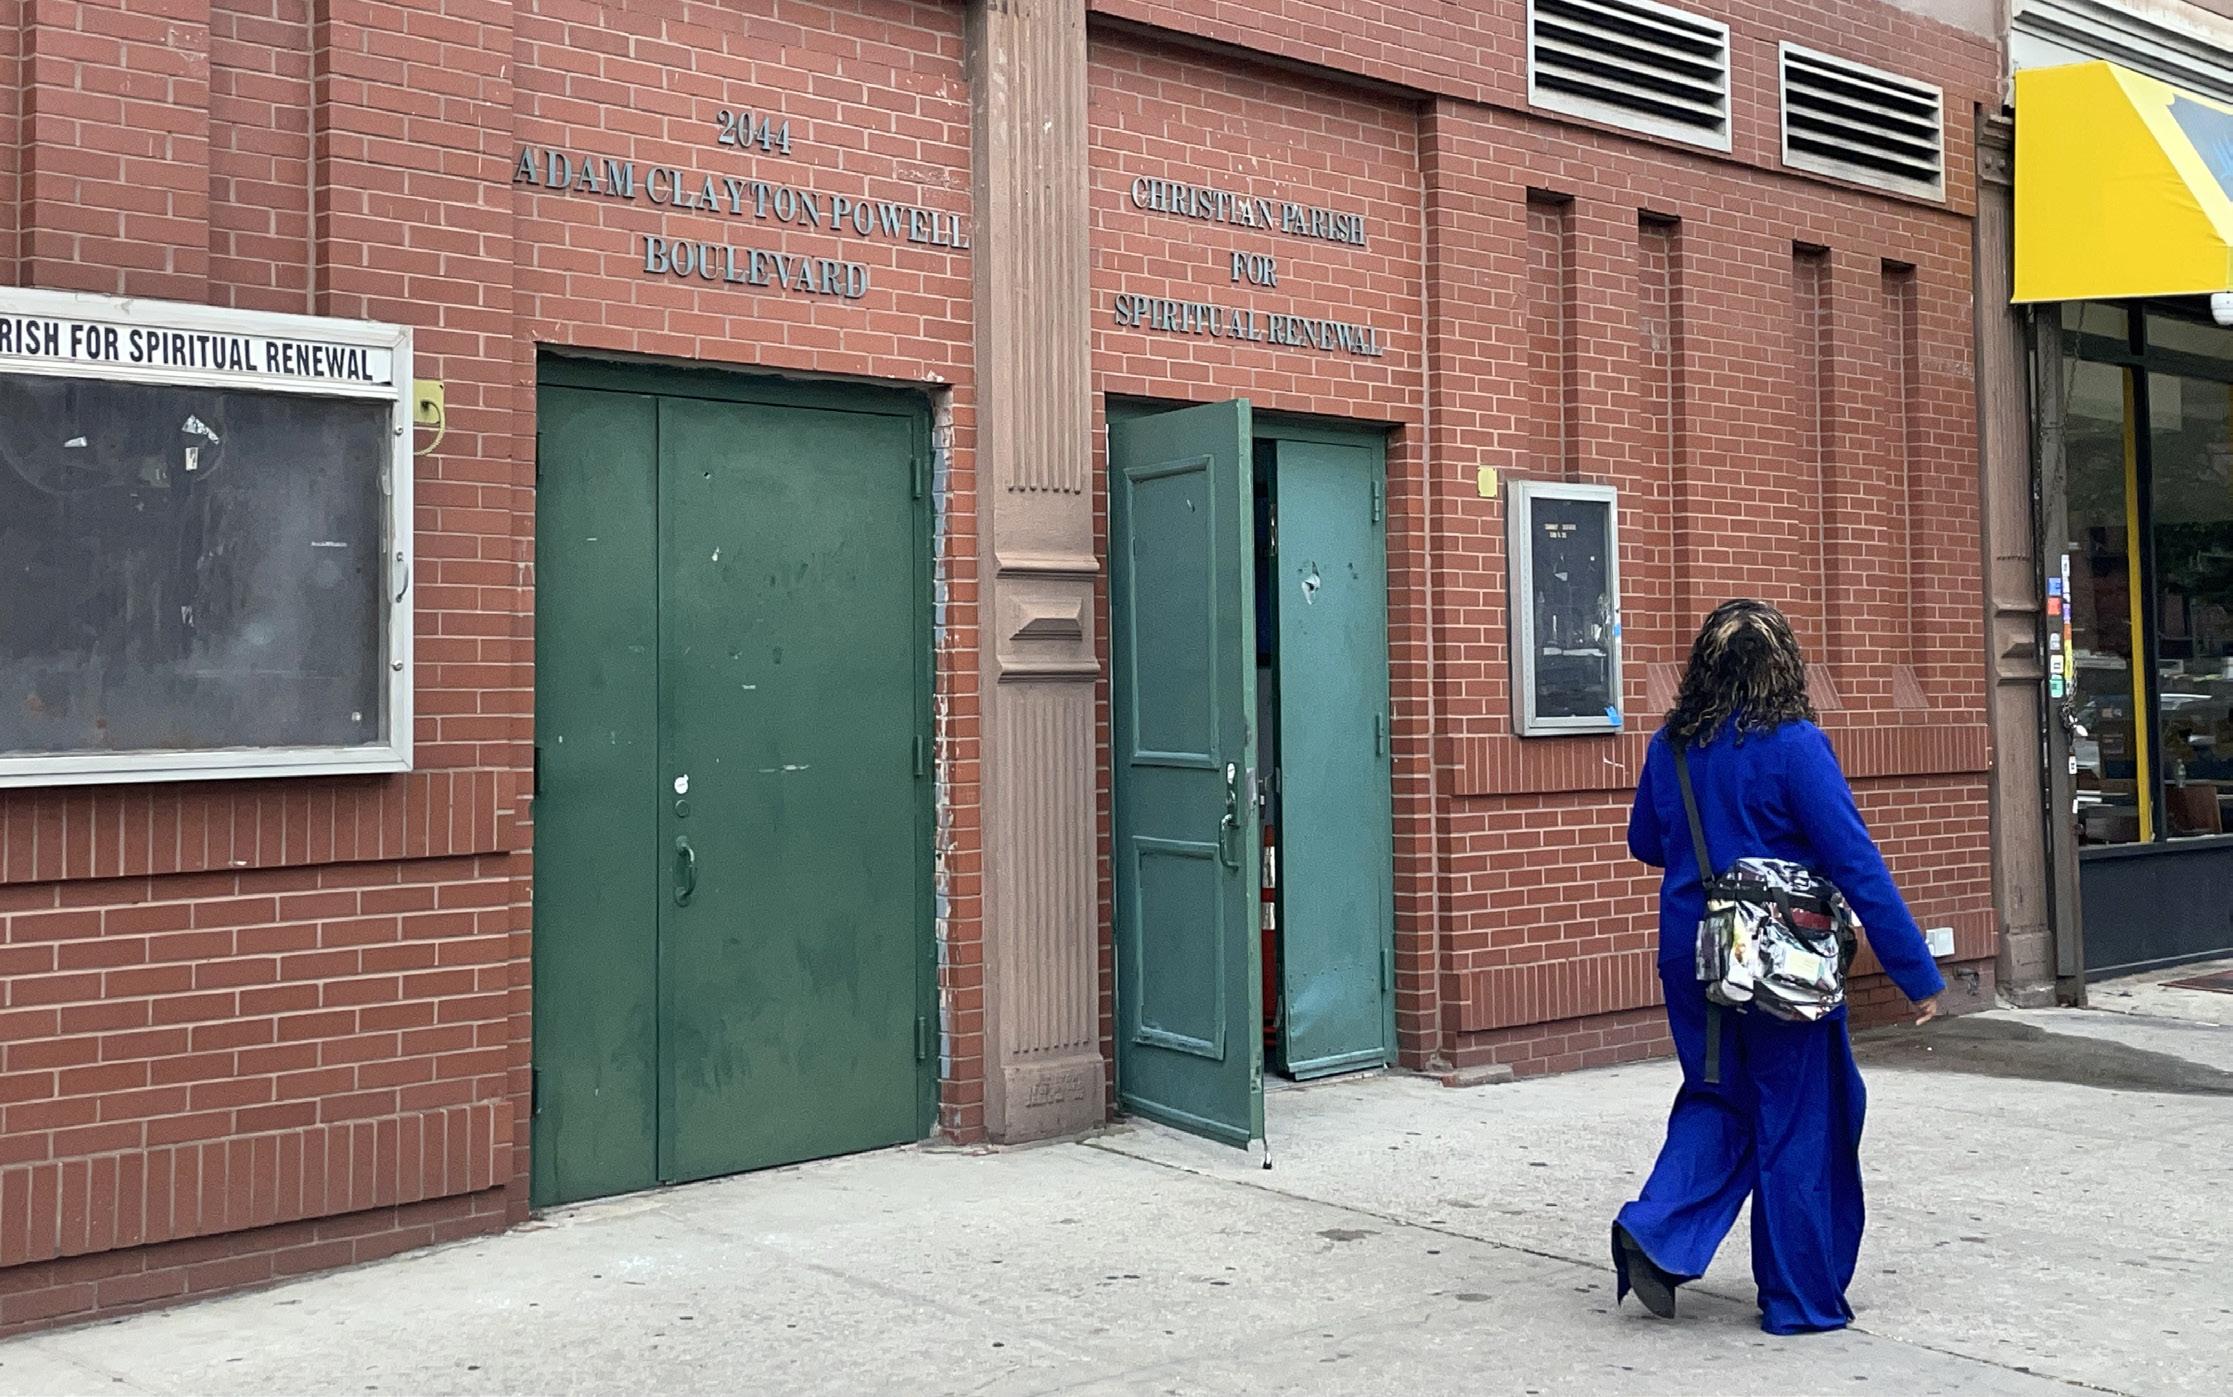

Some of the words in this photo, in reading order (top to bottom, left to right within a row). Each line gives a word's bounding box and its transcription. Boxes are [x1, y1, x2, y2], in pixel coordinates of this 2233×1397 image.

[717, 109, 792, 155] 2044
[513, 145, 636, 200] ADAM
[645, 166, 821, 228] CLAYTON
[830, 195, 970, 249] POWELL
[1131, 175, 1273, 231] CHRISTIAN
[1280, 203, 1366, 246] PARISH
[643, 234, 870, 299] BOULEVARD
[1231, 251, 1278, 288] FOR
[0, 317, 60, 356] RISH
[71, 324, 119, 361] FOR
[129, 329, 258, 372] SPIRITUAL
[266, 341, 374, 382] RENEWAL
[1115, 293, 1263, 342] SPIRITUAL
[1267, 313, 1383, 357] RENEWAL
